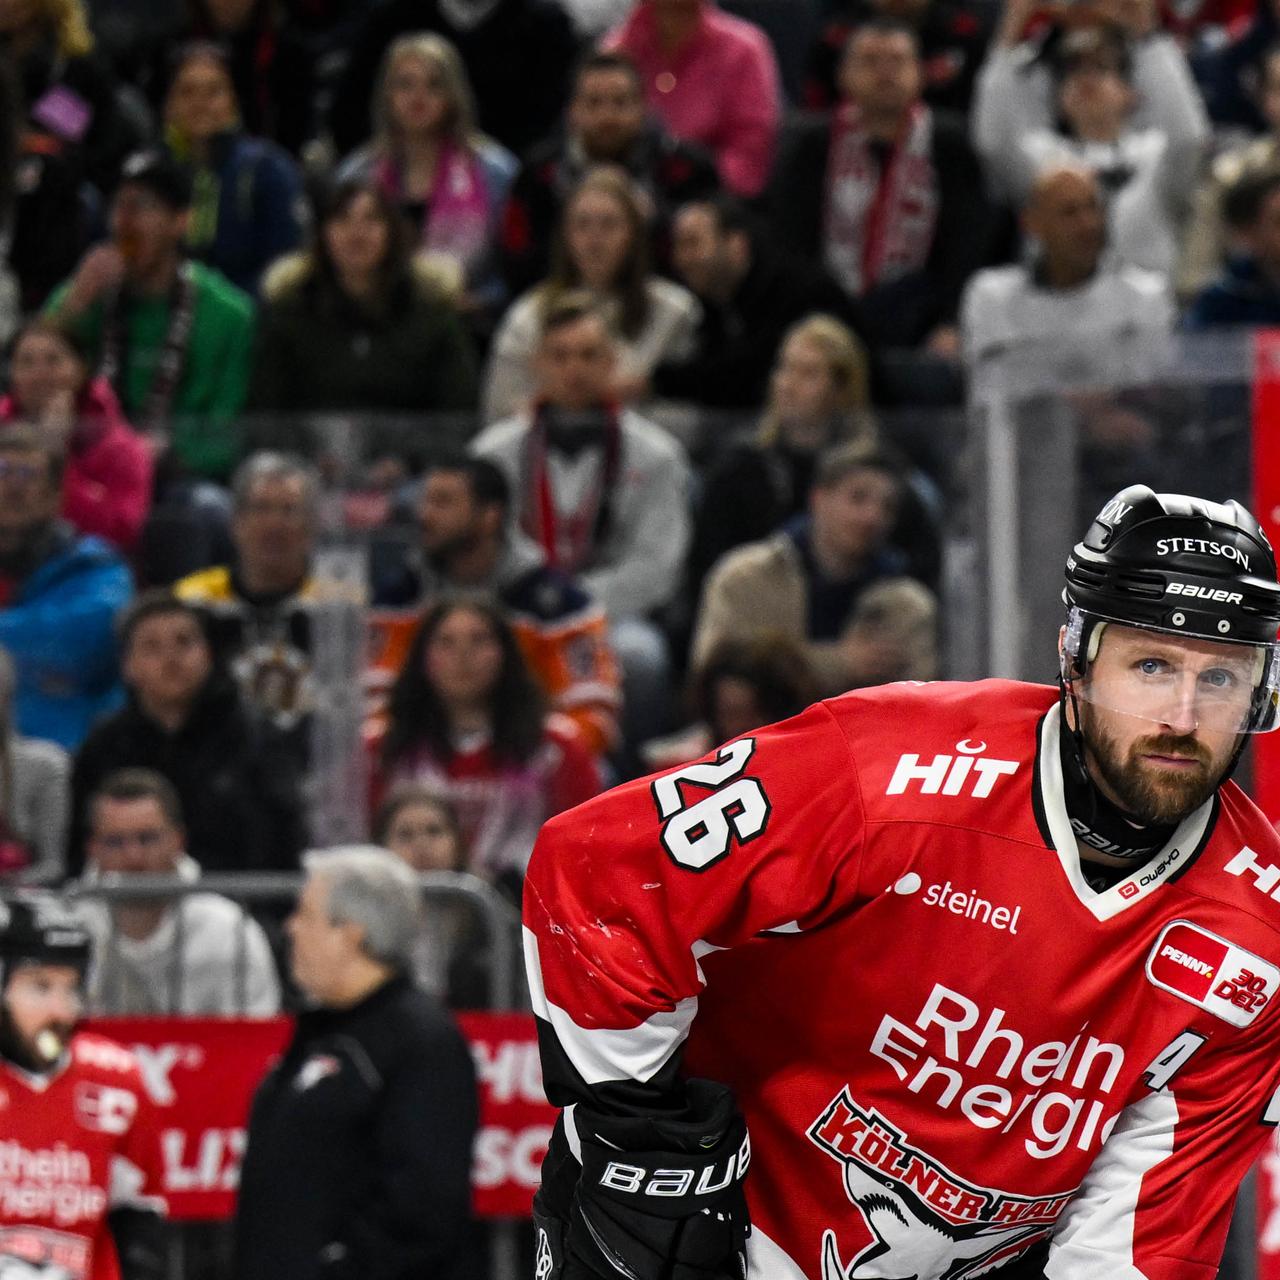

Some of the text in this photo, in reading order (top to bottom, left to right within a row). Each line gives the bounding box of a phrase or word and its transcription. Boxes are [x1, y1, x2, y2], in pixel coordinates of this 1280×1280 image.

[1165, 582, 1244, 606] BAUER
[651, 737, 772, 873] 26
[921, 879, 1023, 936] steinel
[914, 982, 1126, 1095] Rhein
[1143, 1030, 1209, 1092] A
[815, 1102, 1073, 1226] KÖLNER HAI
